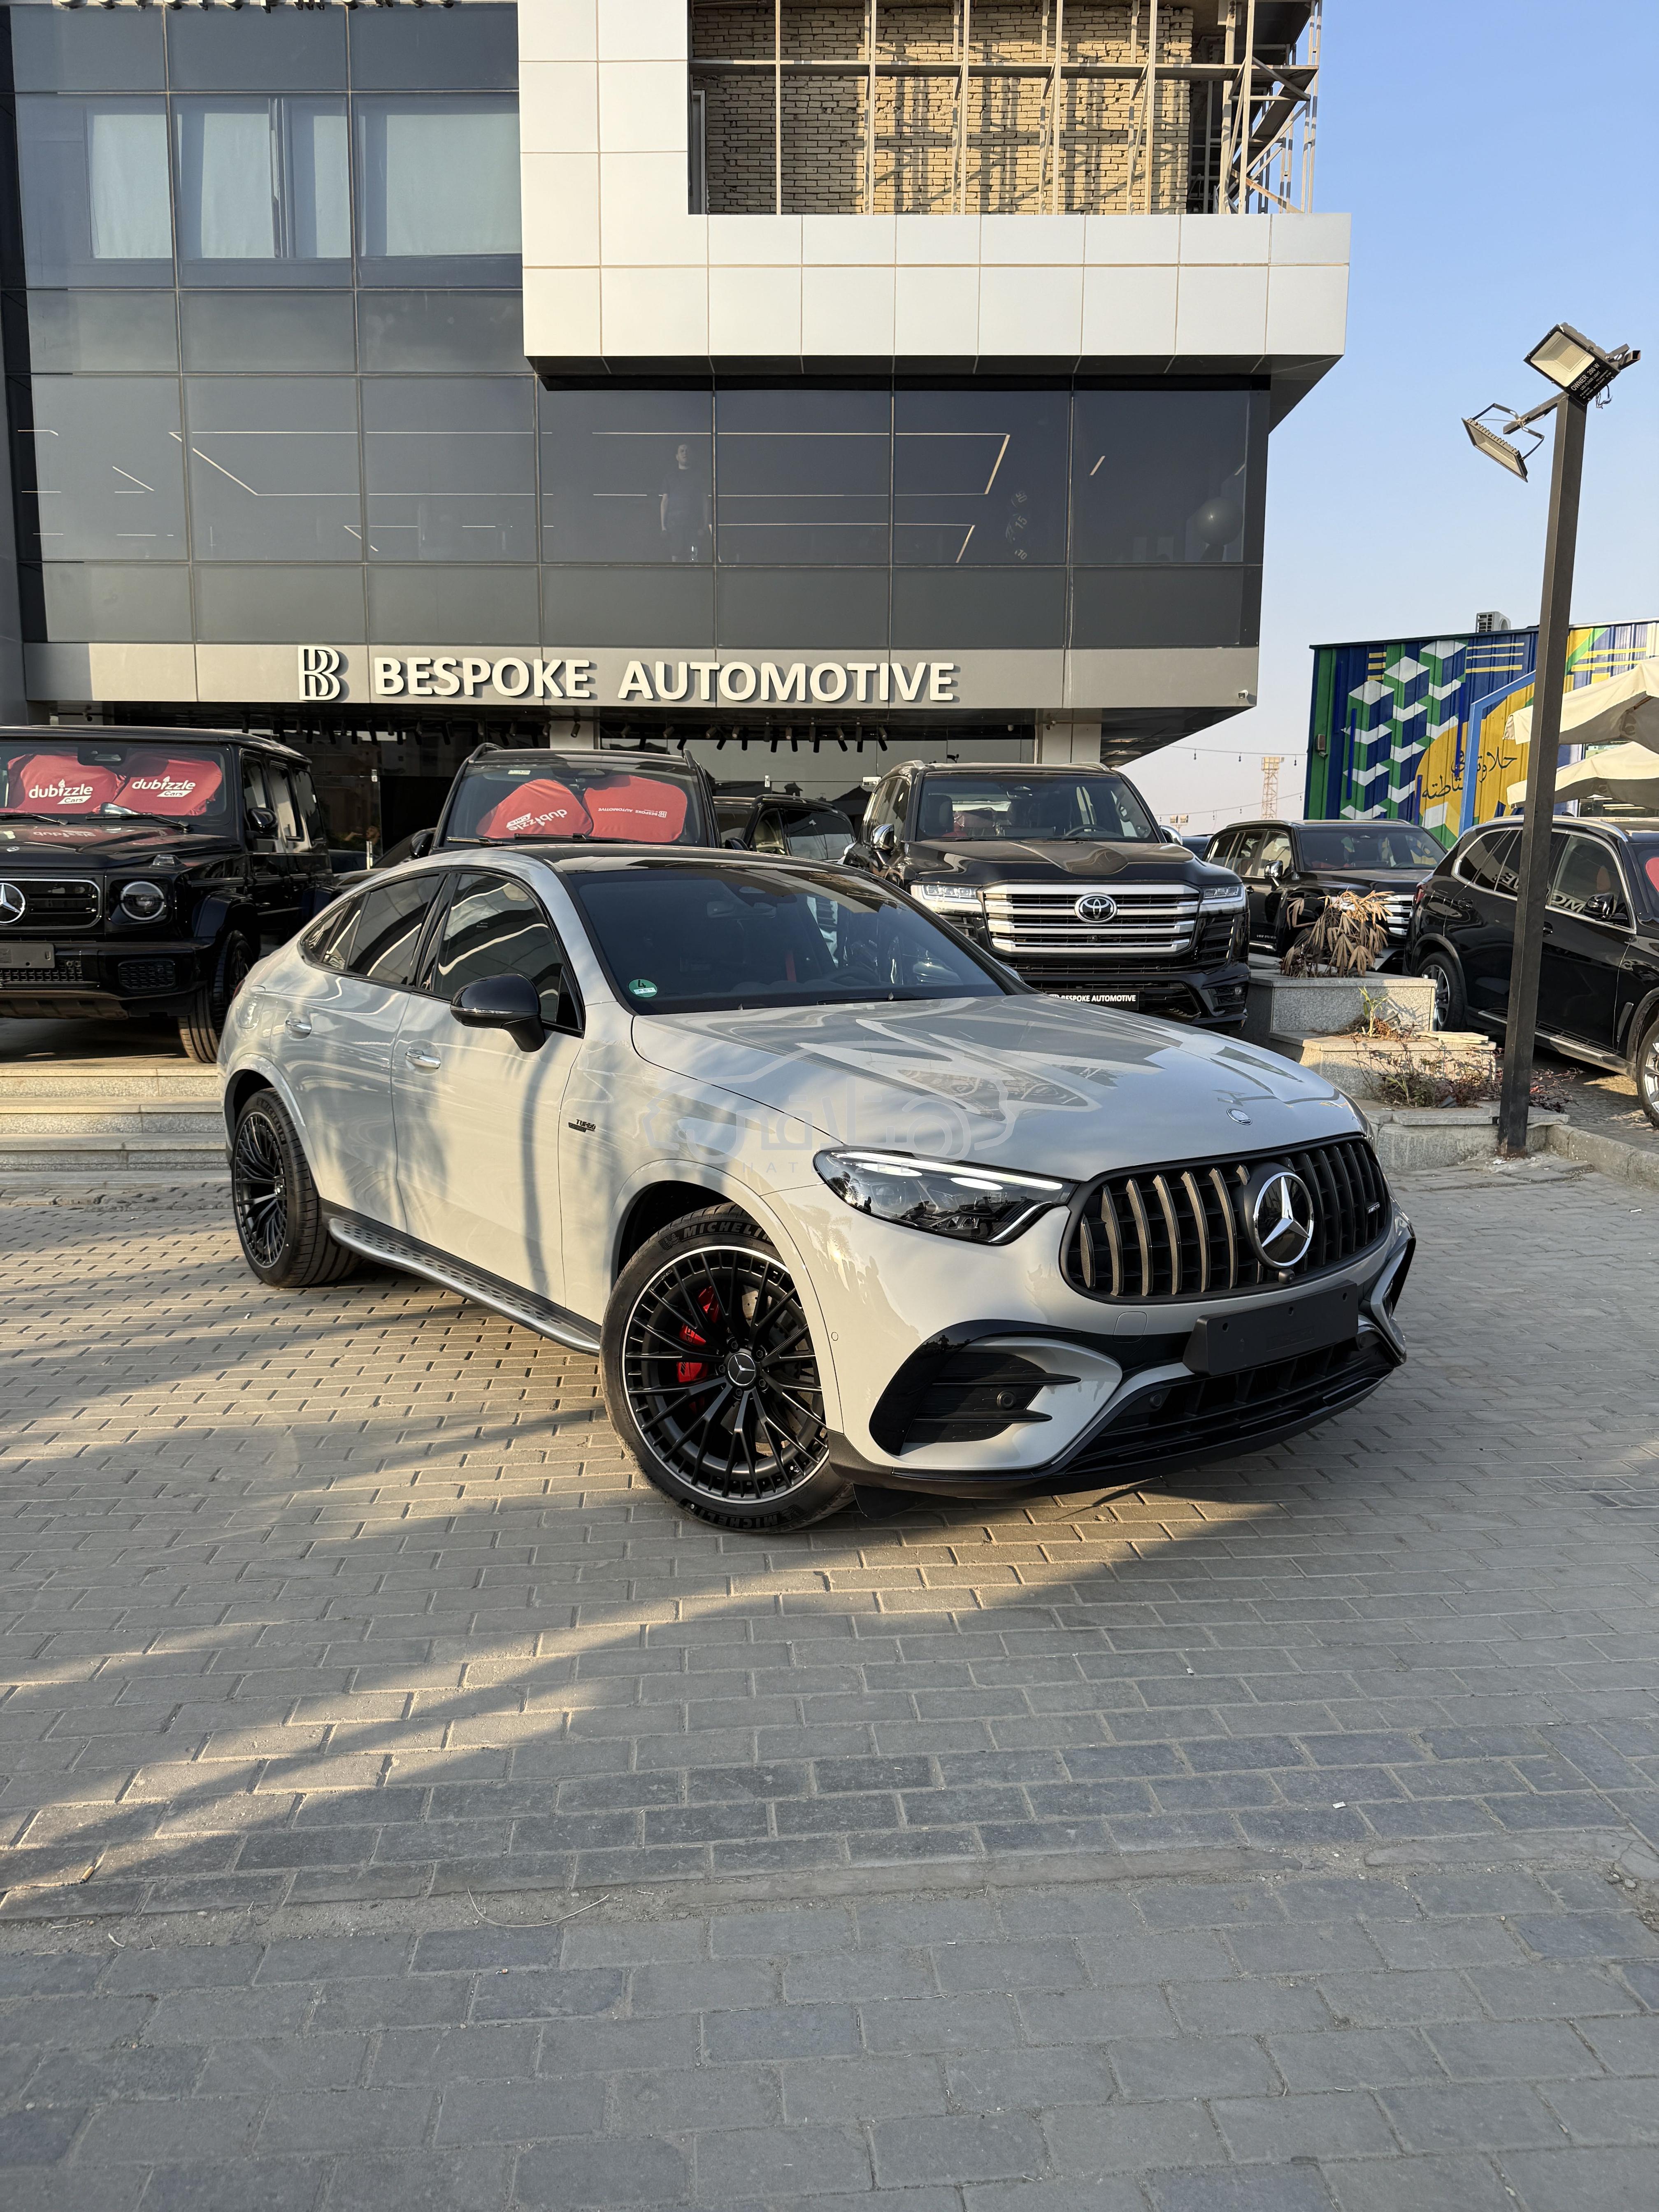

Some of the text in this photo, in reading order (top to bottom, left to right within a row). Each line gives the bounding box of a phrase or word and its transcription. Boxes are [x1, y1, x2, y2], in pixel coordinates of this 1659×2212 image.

[1571, 375, 1589, 391] OWNER
[374, 658, 590, 698] BESPOKE
[617, 661, 954, 701] AUTOMOTIVE
[29, 779, 93, 798] dubizzle
[132, 776, 196, 790] dubizzle
[508, 809, 567, 830] dubizzle
[638, 980, 646, 988] 4
